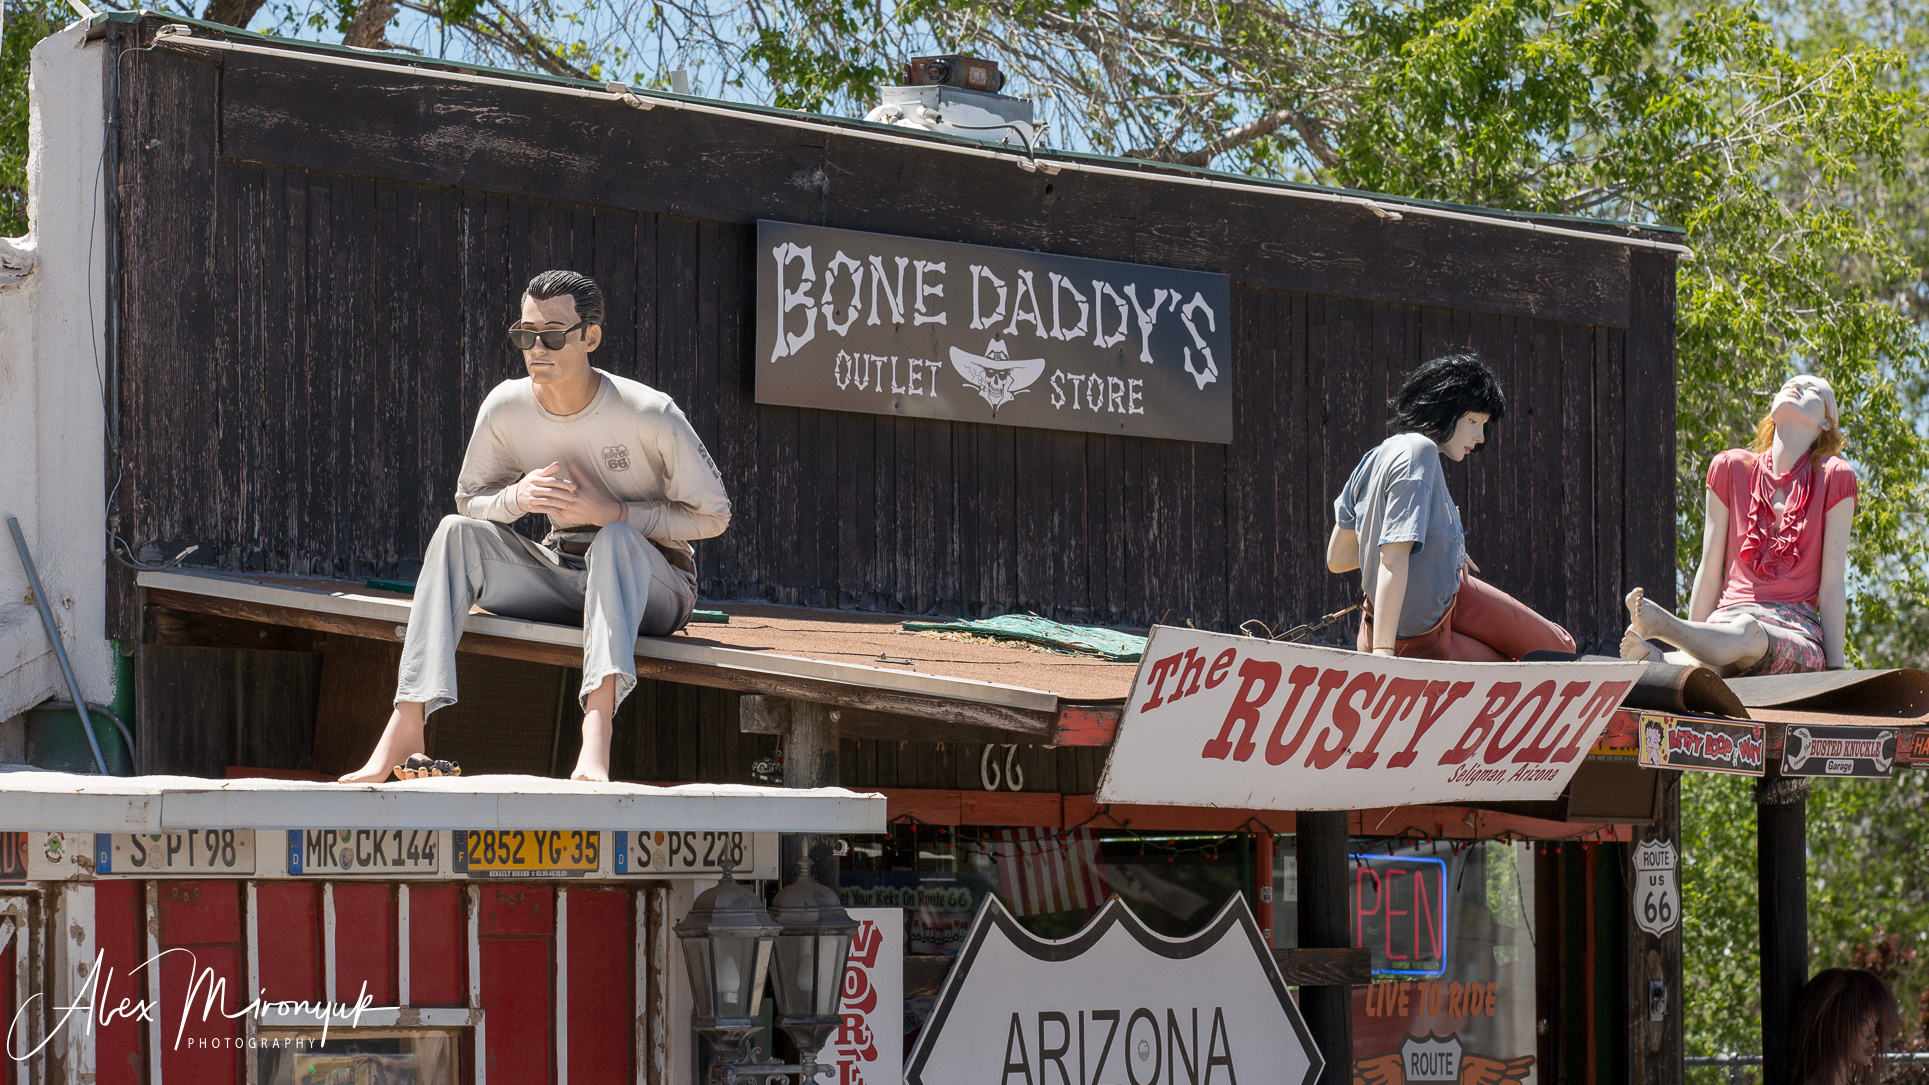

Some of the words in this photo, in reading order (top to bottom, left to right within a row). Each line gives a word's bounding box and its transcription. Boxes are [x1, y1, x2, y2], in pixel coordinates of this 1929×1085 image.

[771, 242, 947, 363] BONE
[969, 264, 1218, 390] DADDY'S
[834, 349, 942, 397] OUTLET
[1050, 368, 1144, 414] STORE
[607, 458, 628, 469] 66
[1140, 646, 1237, 715] The
[1201, 657, 1474, 770] RUSTY
[1438, 679, 1632, 766] BOLT
[1667, 728, 1704, 756] BETTY
[1704, 732, 1733, 758] BOOP
[1738, 735, 1762, 763] WAY
[1810, 740, 1842, 756] BUSTED
[1843, 741, 1881, 758] KNUCKLE
[1447, 762, 1507, 787] Seligman,
[1506, 763, 1560, 783] Arizona
[1828, 761, 1852, 773] Garage
[101, 852, 107, 863] D
[205, 829, 236, 867] 98
[292, 854, 299, 865] D
[306, 830, 338, 867] MR
[356, 830, 388, 867] CK
[391, 830, 435, 867] 144
[458, 852, 464, 862] F
[468, 830, 525, 865] 2852
[533, 830, 562, 865] YG
[570, 830, 598, 865] 35
[618, 854, 625, 865] D
[637, 831, 652, 867] S
[667, 831, 697, 867] PS
[703, 831, 743, 867] 228
[1643, 851, 1670, 867] ROUTE
[1649, 875, 1665, 886] US
[852, 890, 873, 906] Your
[876, 890, 899, 906] Kicks
[903, 890, 915, 906] On
[918, 891, 945, 907] Route
[948, 890, 968, 907] 66
[1350, 868, 1443, 960] PEN
[1643, 890, 1672, 925] 66
[1365, 981, 1411, 1018] LIVE
[1417, 981, 1442, 1018] TO
[1448, 981, 1498, 1020] RIDE
[1000, 1006, 1236, 1085] ARIZONA
[1411, 1052, 1453, 1076] ROUTE
